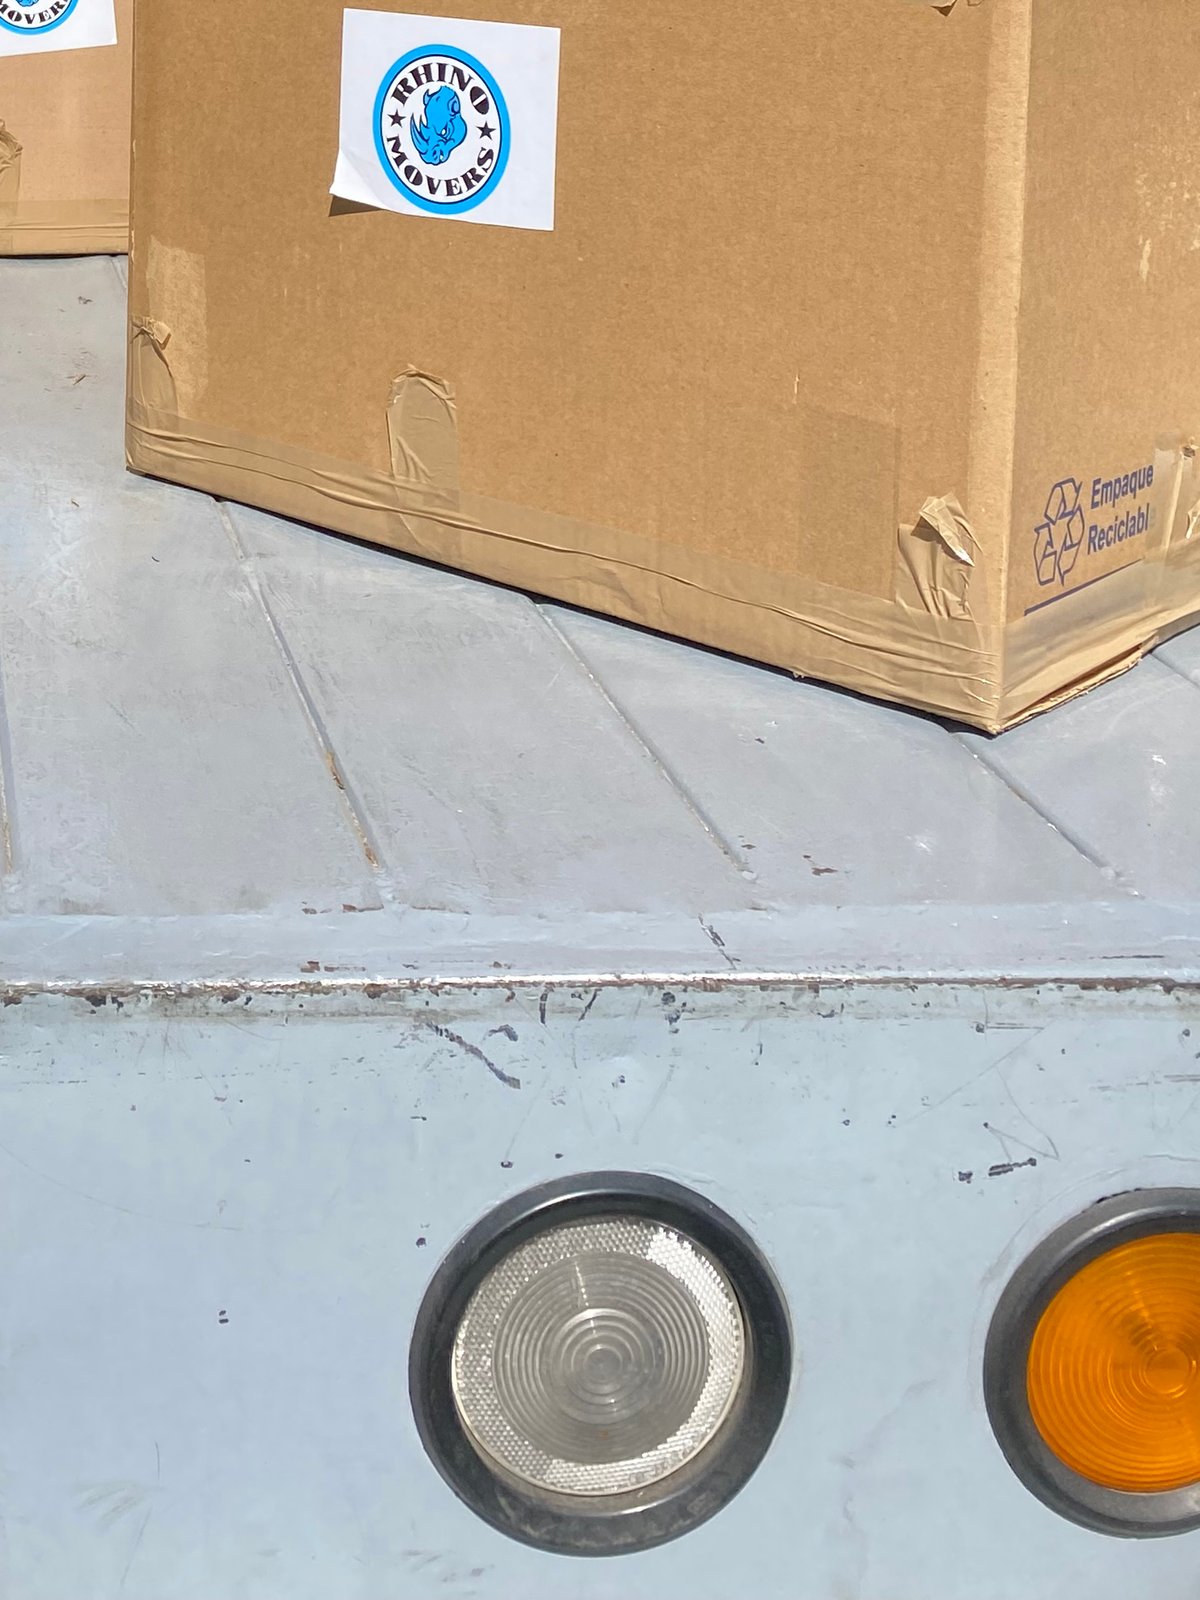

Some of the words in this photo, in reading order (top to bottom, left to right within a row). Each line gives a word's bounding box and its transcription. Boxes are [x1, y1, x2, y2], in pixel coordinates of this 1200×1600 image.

[390, 62, 490, 115] RHINO
[387, 133, 494, 196] MOVERS
[1090, 464, 1154, 510] Empaque
